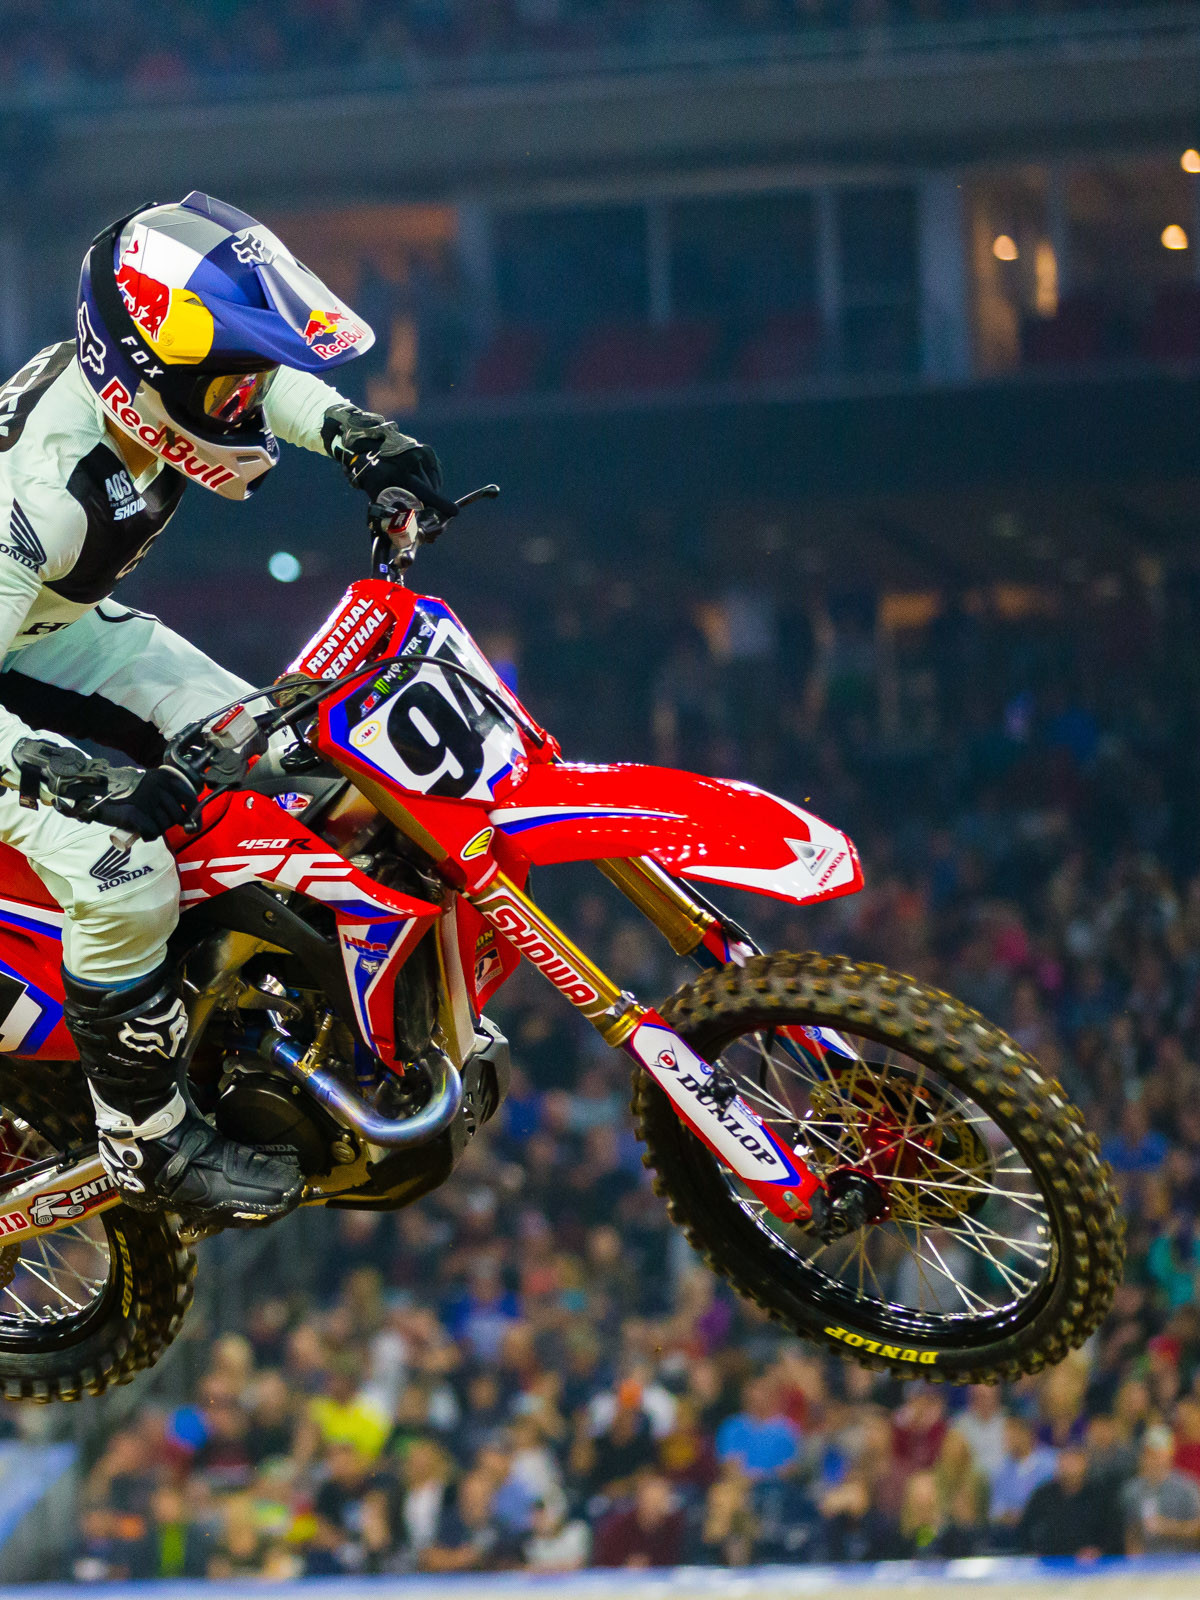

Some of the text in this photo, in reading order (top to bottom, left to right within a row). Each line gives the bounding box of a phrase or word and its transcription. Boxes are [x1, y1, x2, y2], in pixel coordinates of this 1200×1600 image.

[121, 335, 164, 378] FOX
[312, 323, 367, 359] Red Bull
[100, 377, 240, 490] Red Bull
[105, 470, 132, 502] AOS
[306, 596, 373, 674] RENTHAL
[321, 608, 387, 681] RENTHAL
[387, 633, 517, 800] 94
[237, 838, 313, 851] 450R
[96, 864, 154, 893] HONDA
[817, 851, 847, 888] HONDA
[484, 903, 600, 1008] SHOWA
[676, 1073, 778, 1166] DUNLOP
[254, 1144, 299, 1152] ONDA
[824, 1325, 940, 1366] DUNLOP
